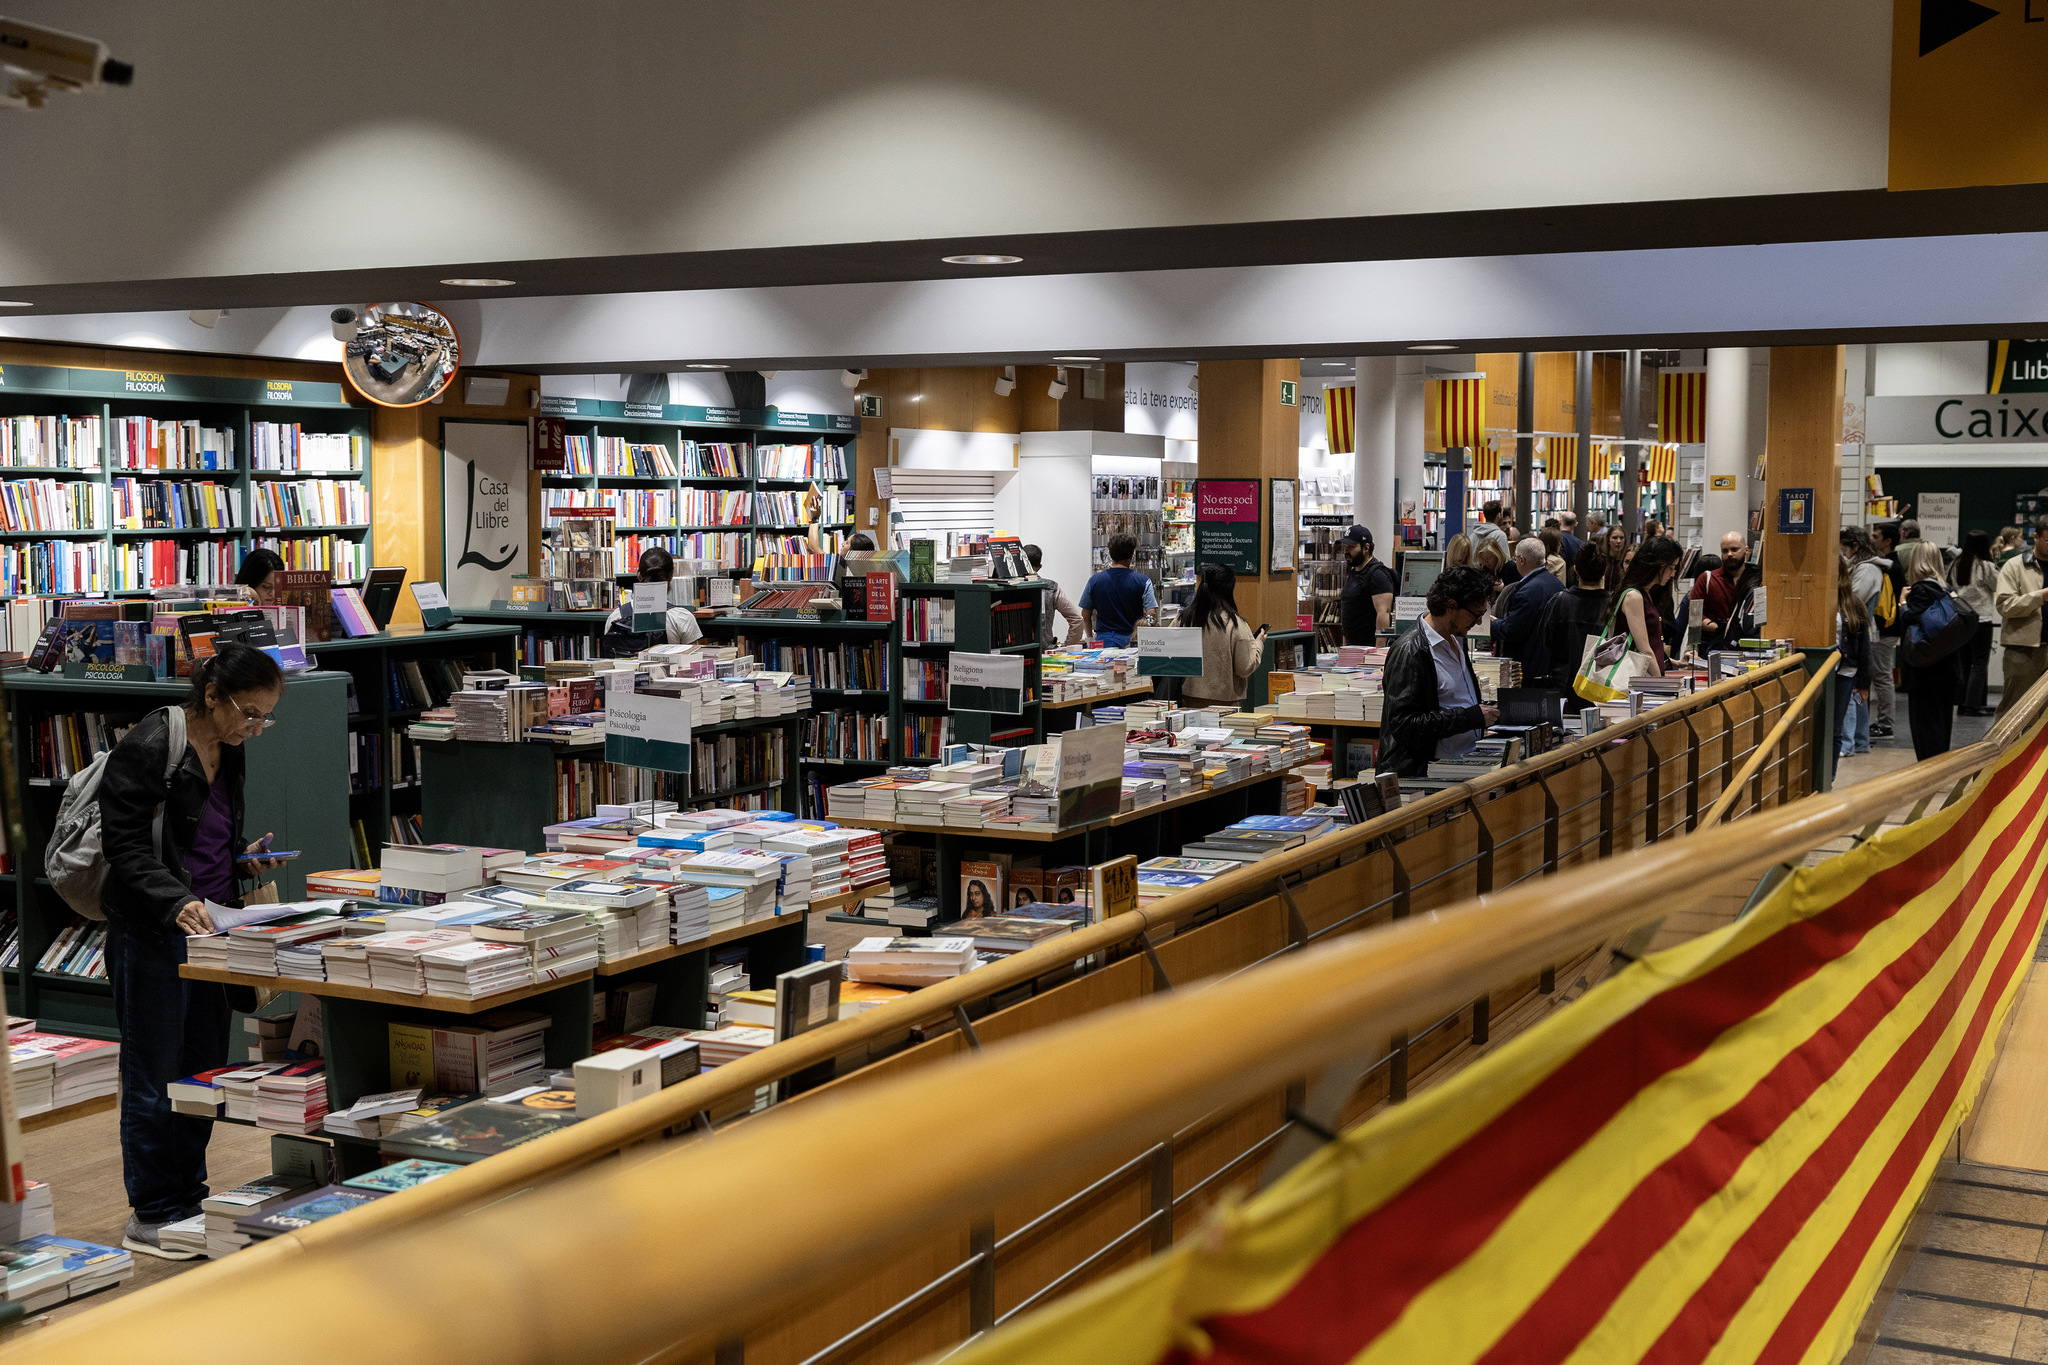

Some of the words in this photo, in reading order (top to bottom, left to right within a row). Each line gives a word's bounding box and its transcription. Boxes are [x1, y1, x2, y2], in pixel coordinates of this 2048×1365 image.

[126, 372, 165, 382] FILOSOFIA
[126, 382, 165, 392] FILOSOFÍA
[267, 382, 292, 390] FILOSOFIA
[267, 391, 292, 400] FILOSOFÍA
[1140, 388, 1148, 406] la
[1150, 390, 1167, 408] teva
[1935, 398, 2048, 439] Caix
[479, 478, 508, 495] Casa
[494, 498, 508, 511] del
[1203, 495, 1217, 504] No
[1218, 496, 1232, 504] ets
[1234, 495, 1253, 504] soci
[1922, 495, 1956, 504] Recollida
[1203, 506, 1237, 514] encara?
[476, 512, 509, 529] Llibre
[87, 663, 125, 672] PSICOLOGIA
[954, 665, 983, 674] Religions
[85, 671, 123, 680] PSICOLOGÍA
[610, 709, 647, 722] Psicologia
[609, 721, 640, 732] Psicología
